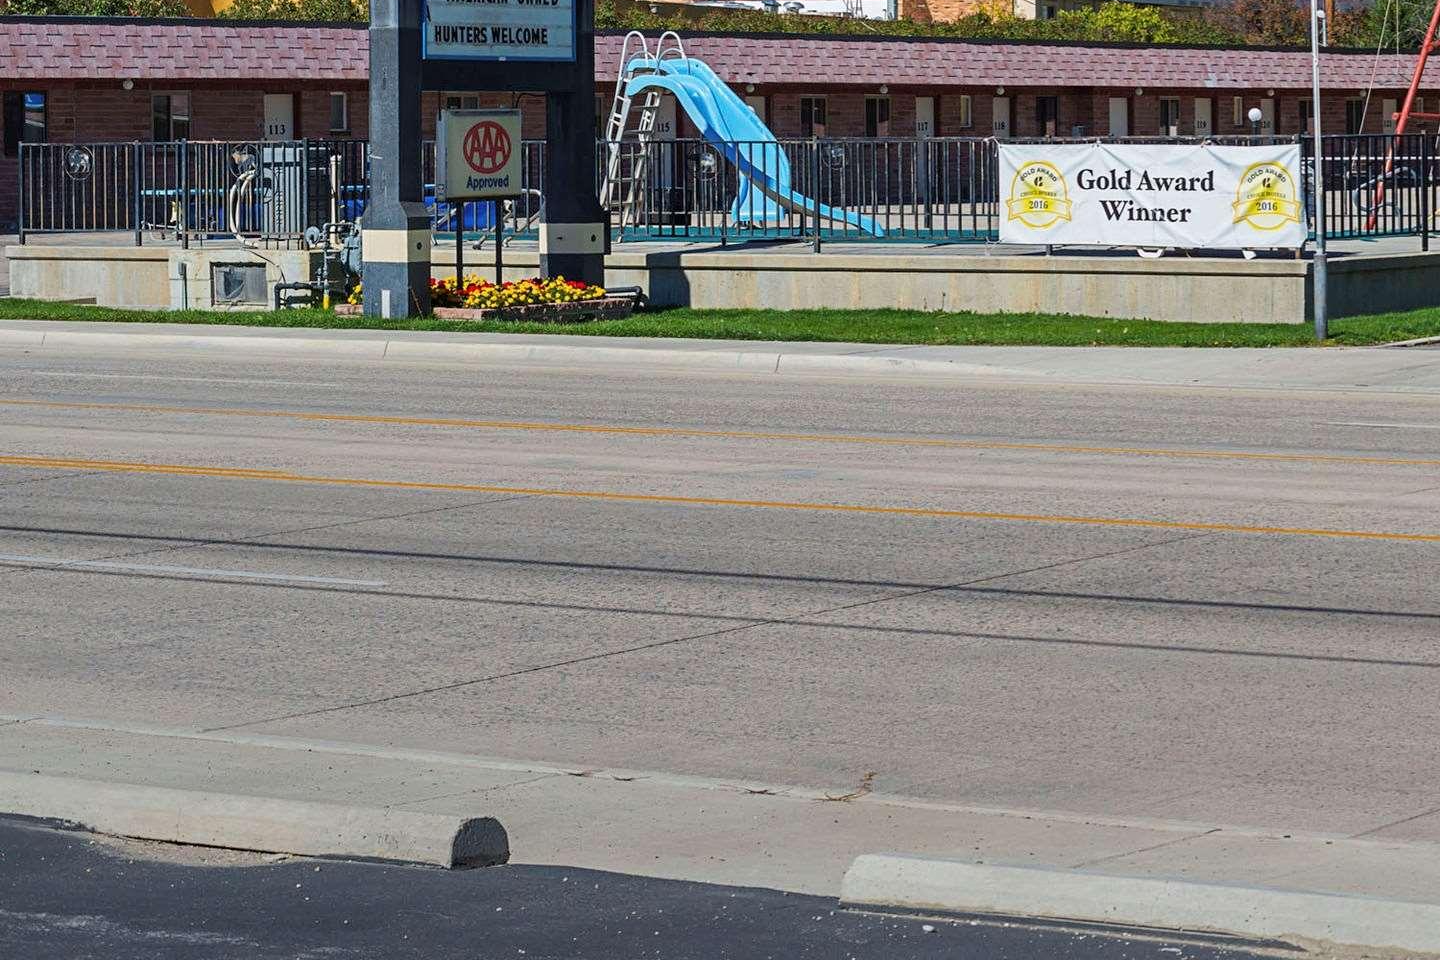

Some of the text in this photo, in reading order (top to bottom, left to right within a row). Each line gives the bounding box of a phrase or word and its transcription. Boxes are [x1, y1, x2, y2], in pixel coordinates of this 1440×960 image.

[434, 25, 548, 45] HUNTERS WELCOME
[269, 124, 286, 135] 113
[465, 124, 510, 172] AAA
[466, 174, 509, 191] Approved
[1076, 169, 1216, 192] Gold Award
[1028, 200, 1049, 209] 2016
[1100, 200, 1192, 223] Winner
[1255, 201, 1278, 211] 2016
